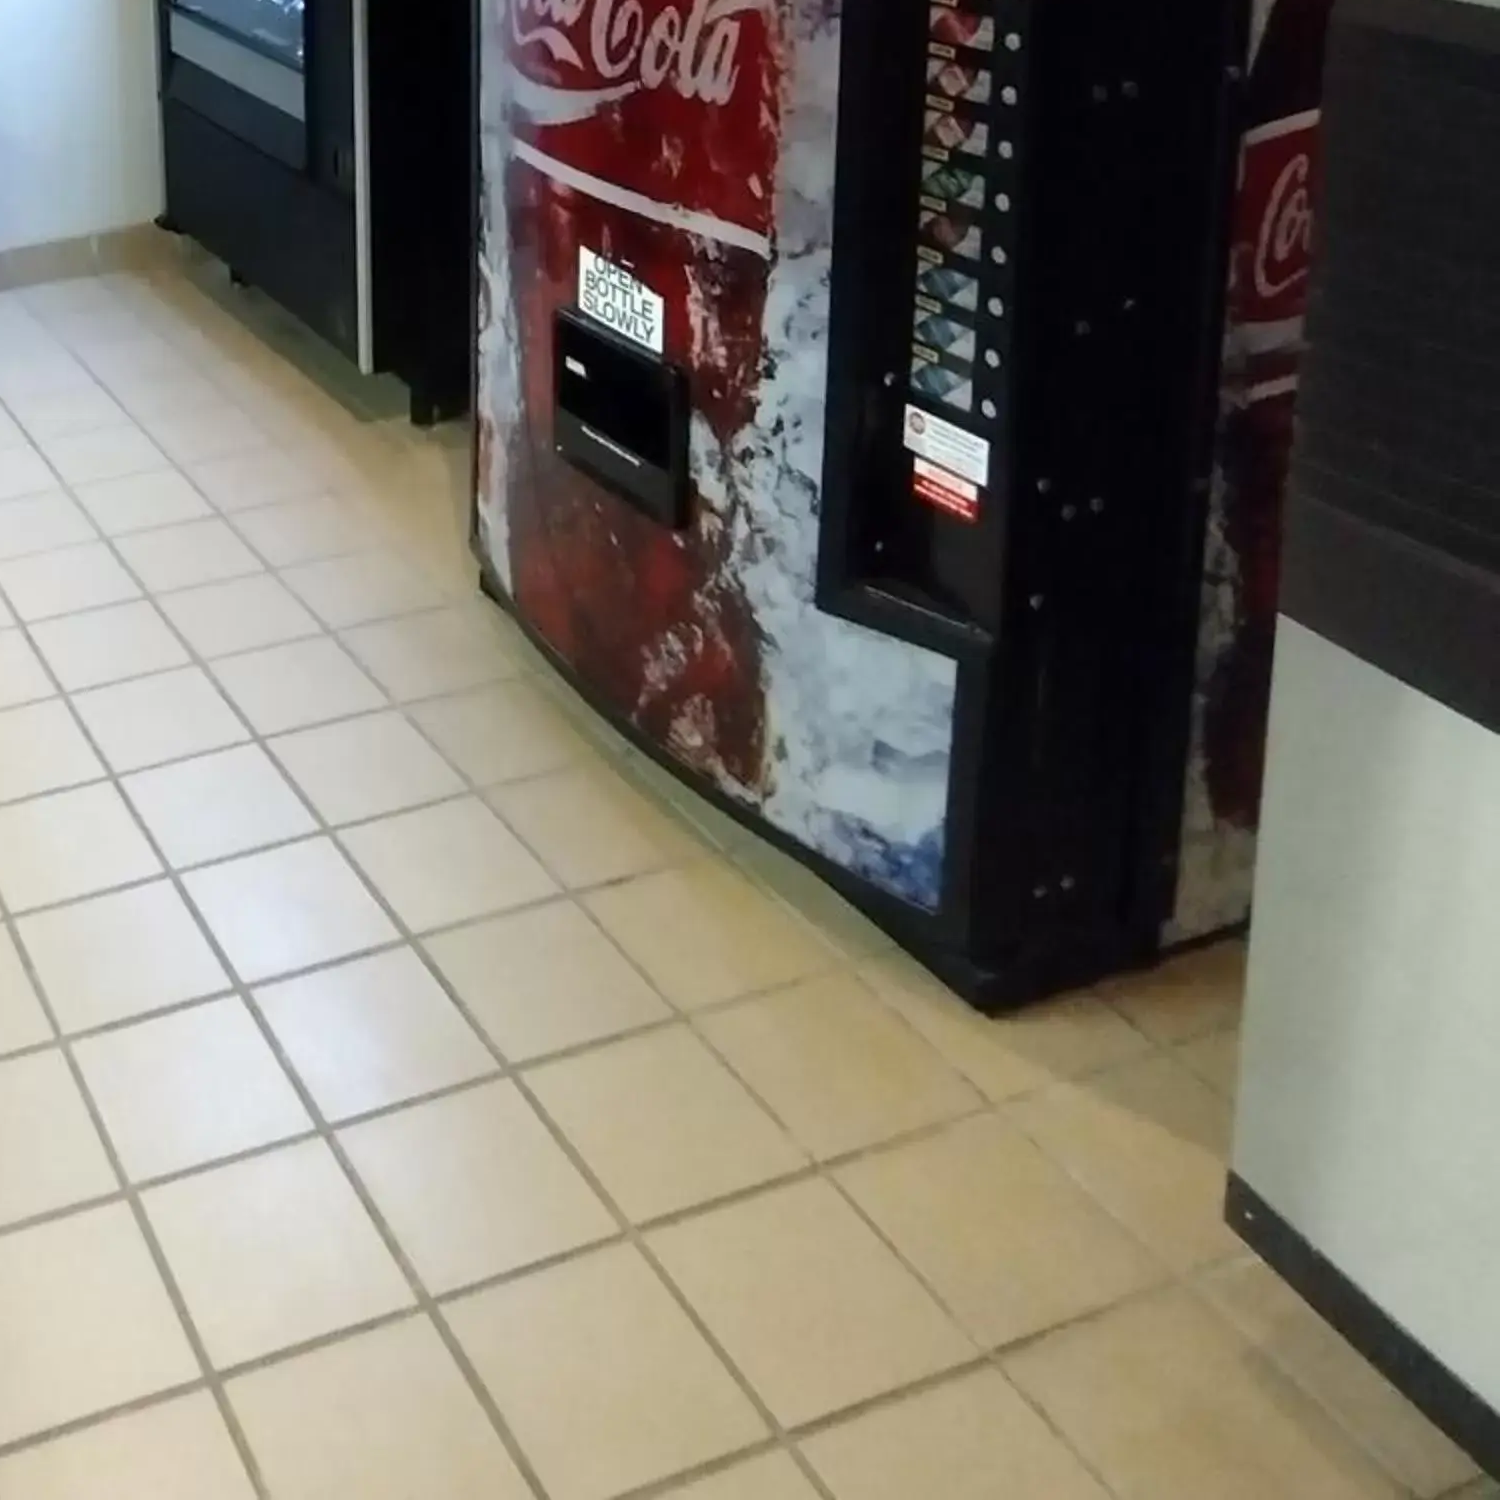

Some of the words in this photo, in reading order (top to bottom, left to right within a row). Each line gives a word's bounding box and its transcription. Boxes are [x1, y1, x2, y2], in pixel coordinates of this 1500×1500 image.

[585, 267, 655, 323] BOTTLE
[594, 255, 644, 295] OPEN
[582, 289, 655, 343] SLOWLY
